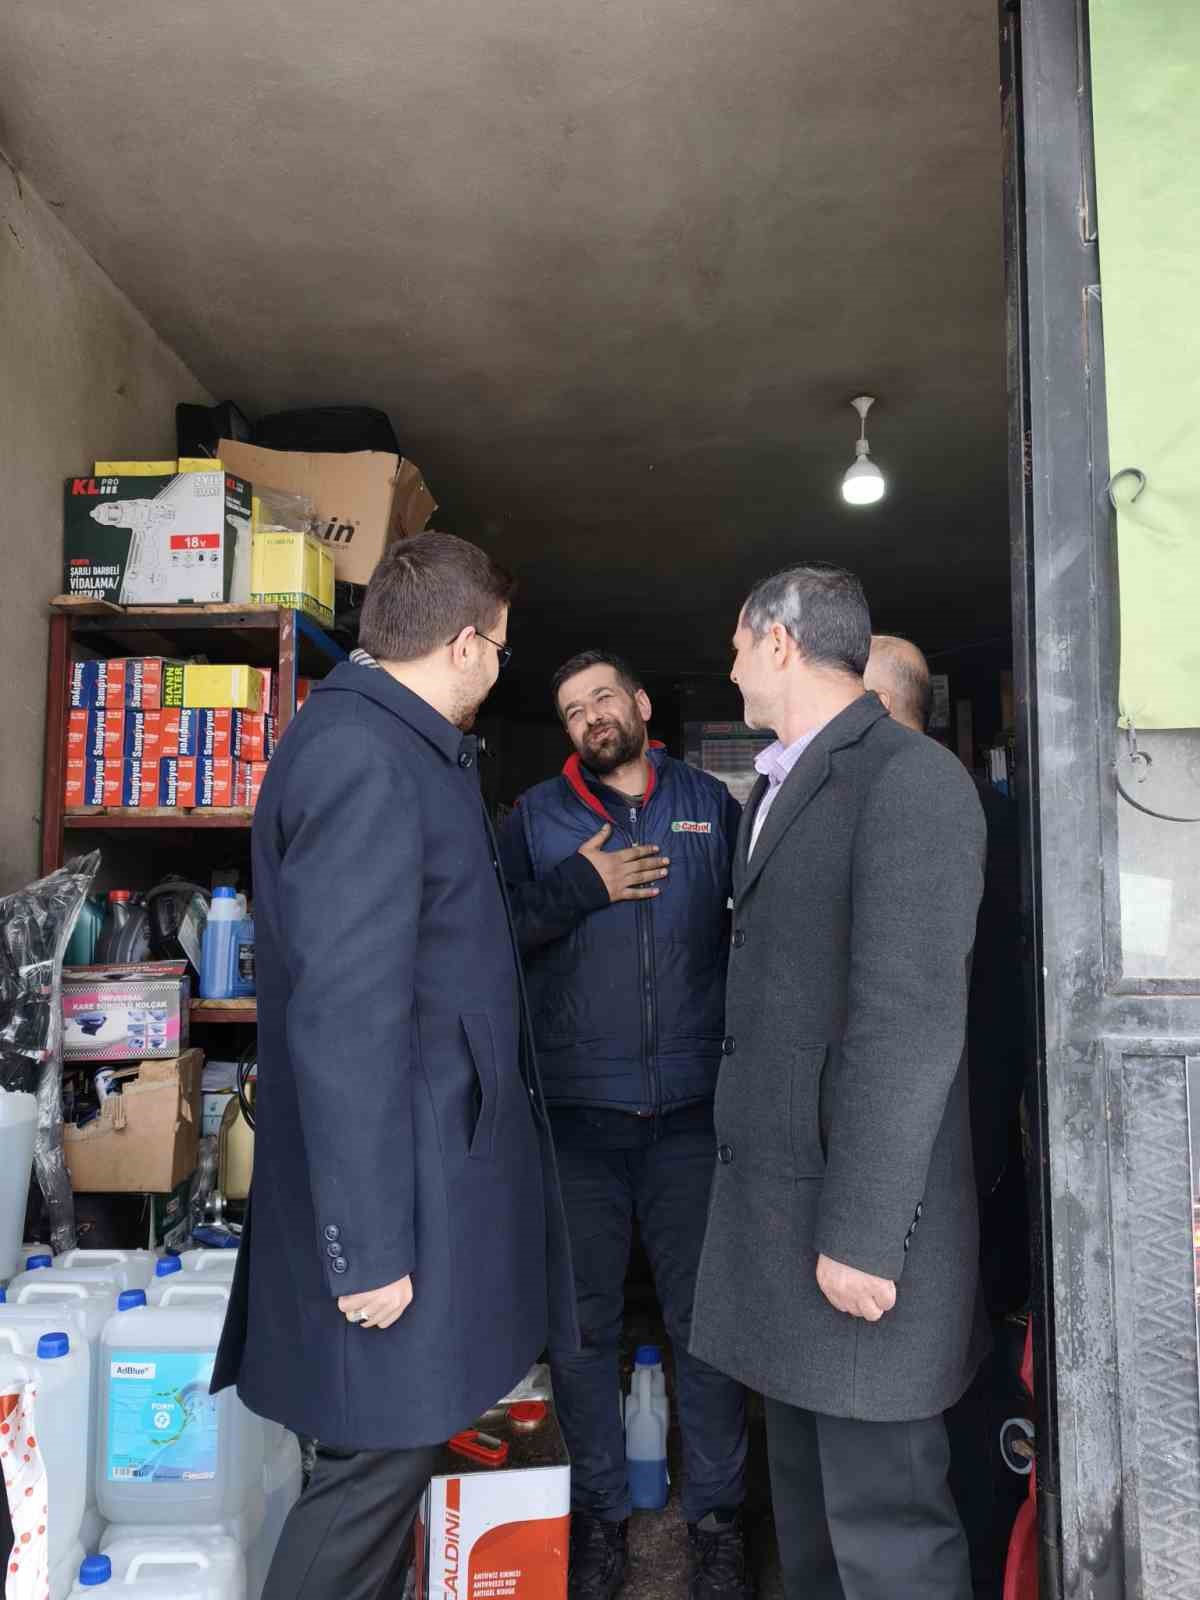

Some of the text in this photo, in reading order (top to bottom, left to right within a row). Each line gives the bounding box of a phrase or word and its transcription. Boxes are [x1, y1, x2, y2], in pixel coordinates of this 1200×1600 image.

[72, 479, 97, 494] KL
[101, 478, 119, 486] PRO
[70, 576, 120, 590] VİDALAMA/
[71, 662, 85, 707] Sampiyon
[95, 662, 107, 707] Sampiyon
[131, 662, 143, 707] Sampiyon
[165, 667, 174, 705] MANN
[174, 667, 183, 705] FILTER
[93, 711, 106, 756] Sampiyon
[132, 712, 145, 757] Sampiyon
[178, 709, 192, 755] Sampiyon
[203, 710, 216, 756] Sampiyon
[92, 759, 105, 804] Sampiyon
[128, 760, 142, 806] Sampiyon
[166, 759, 178, 805] Sampiyon
[202, 759, 215, 804] Sampiyon
